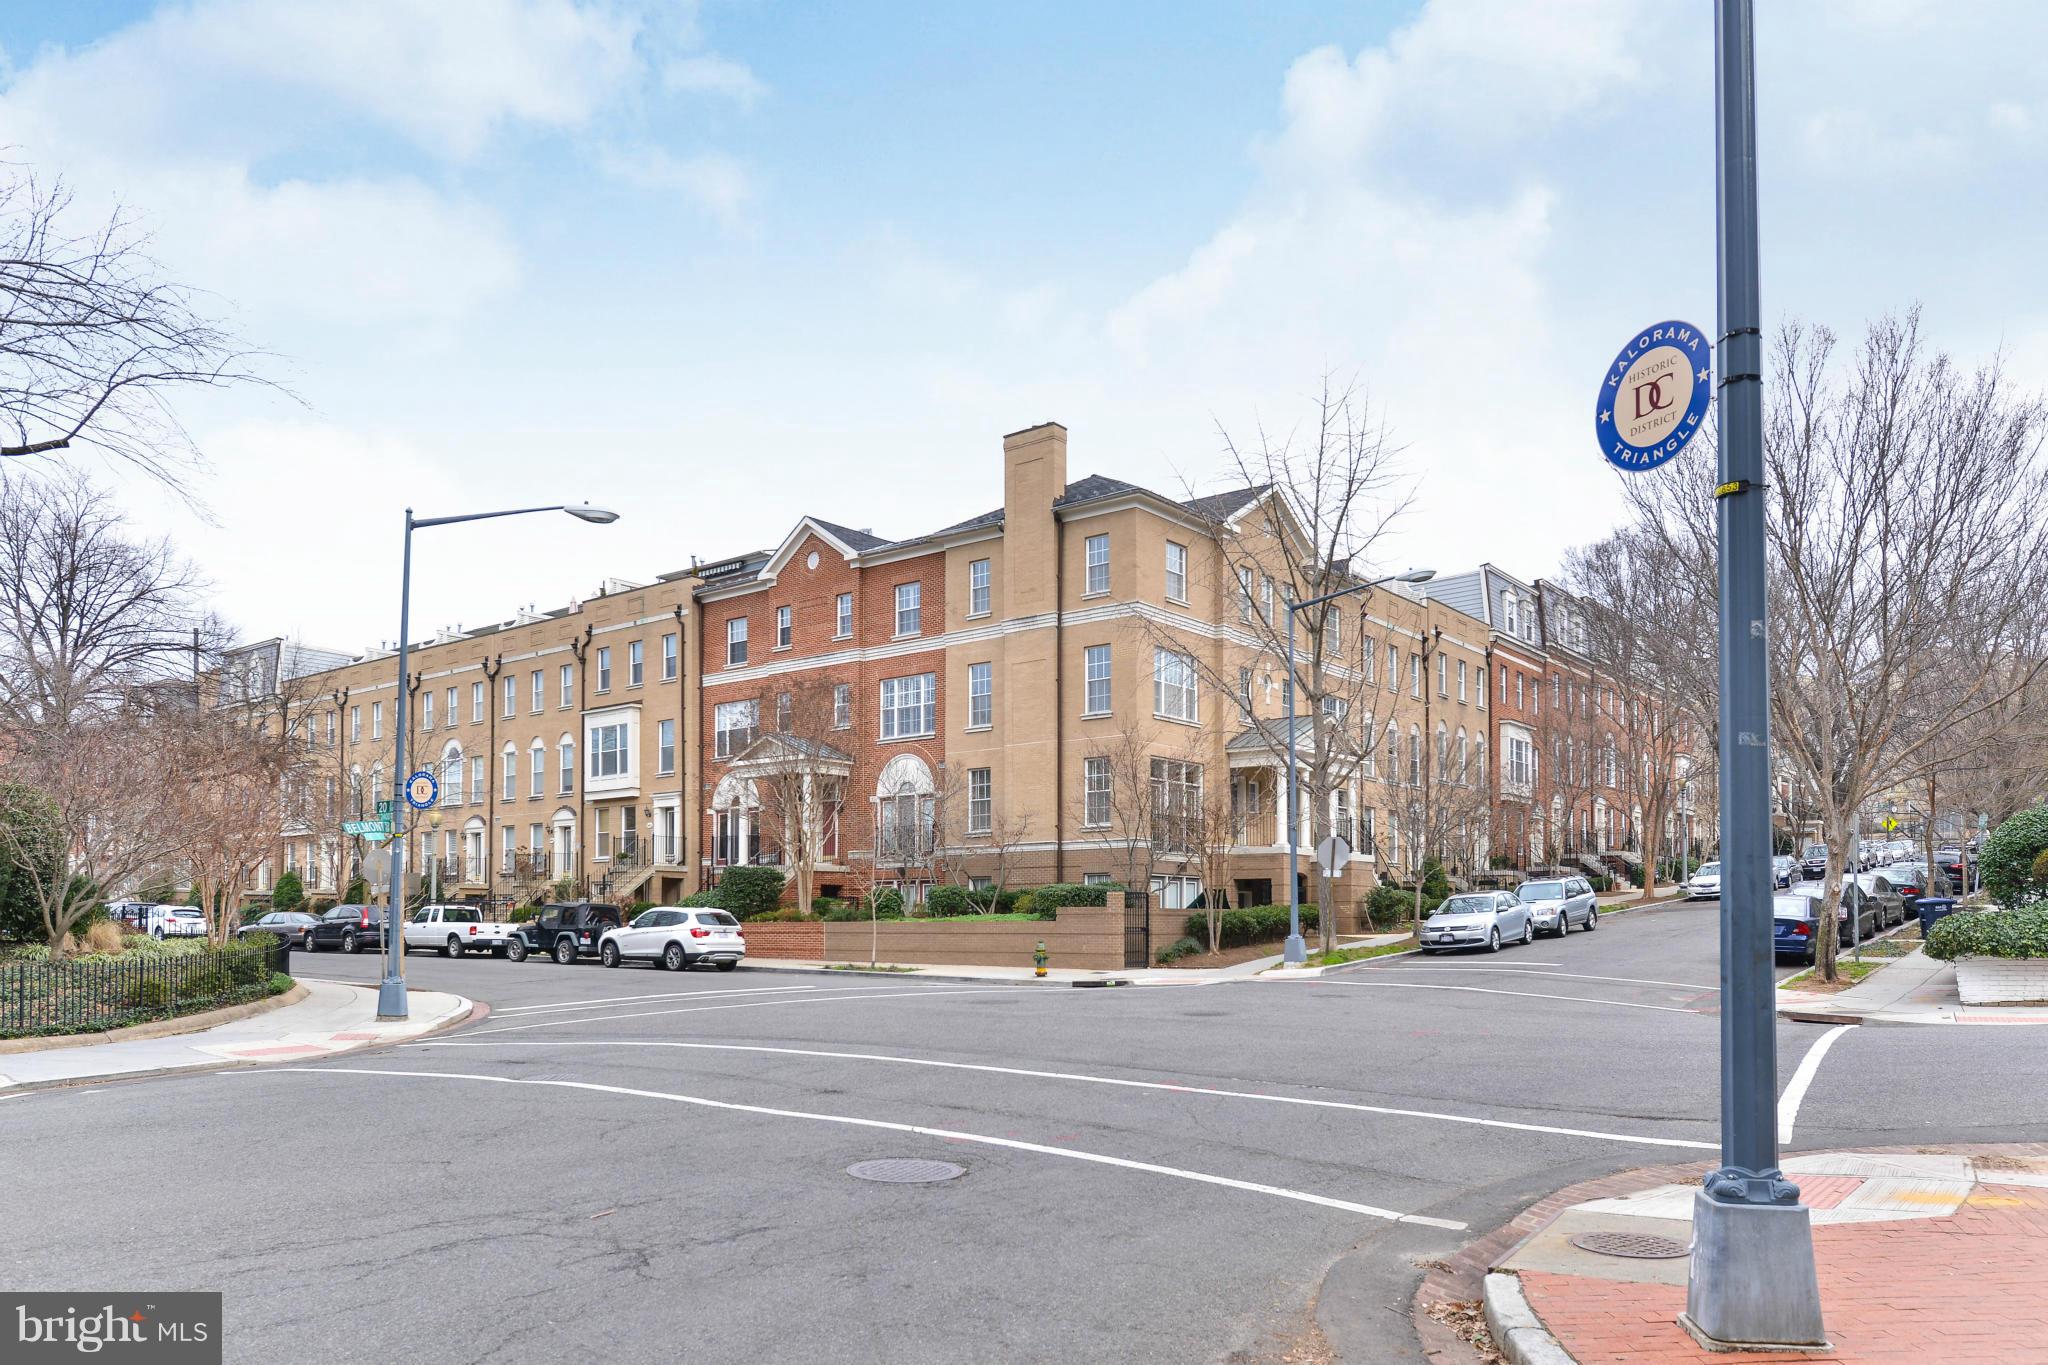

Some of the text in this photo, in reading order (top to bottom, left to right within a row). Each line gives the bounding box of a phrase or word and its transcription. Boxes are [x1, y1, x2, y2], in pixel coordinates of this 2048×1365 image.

[1608, 327, 1698, 387] KALORAMA
[1629, 355, 1678, 384] HISTORIC
[1632, 372, 1675, 421] DC
[1614, 413, 1699, 464] TRIANGLE
[1630, 410, 1677, 437] DISTRICT
[344, 821, 384, 834] BELMONT
